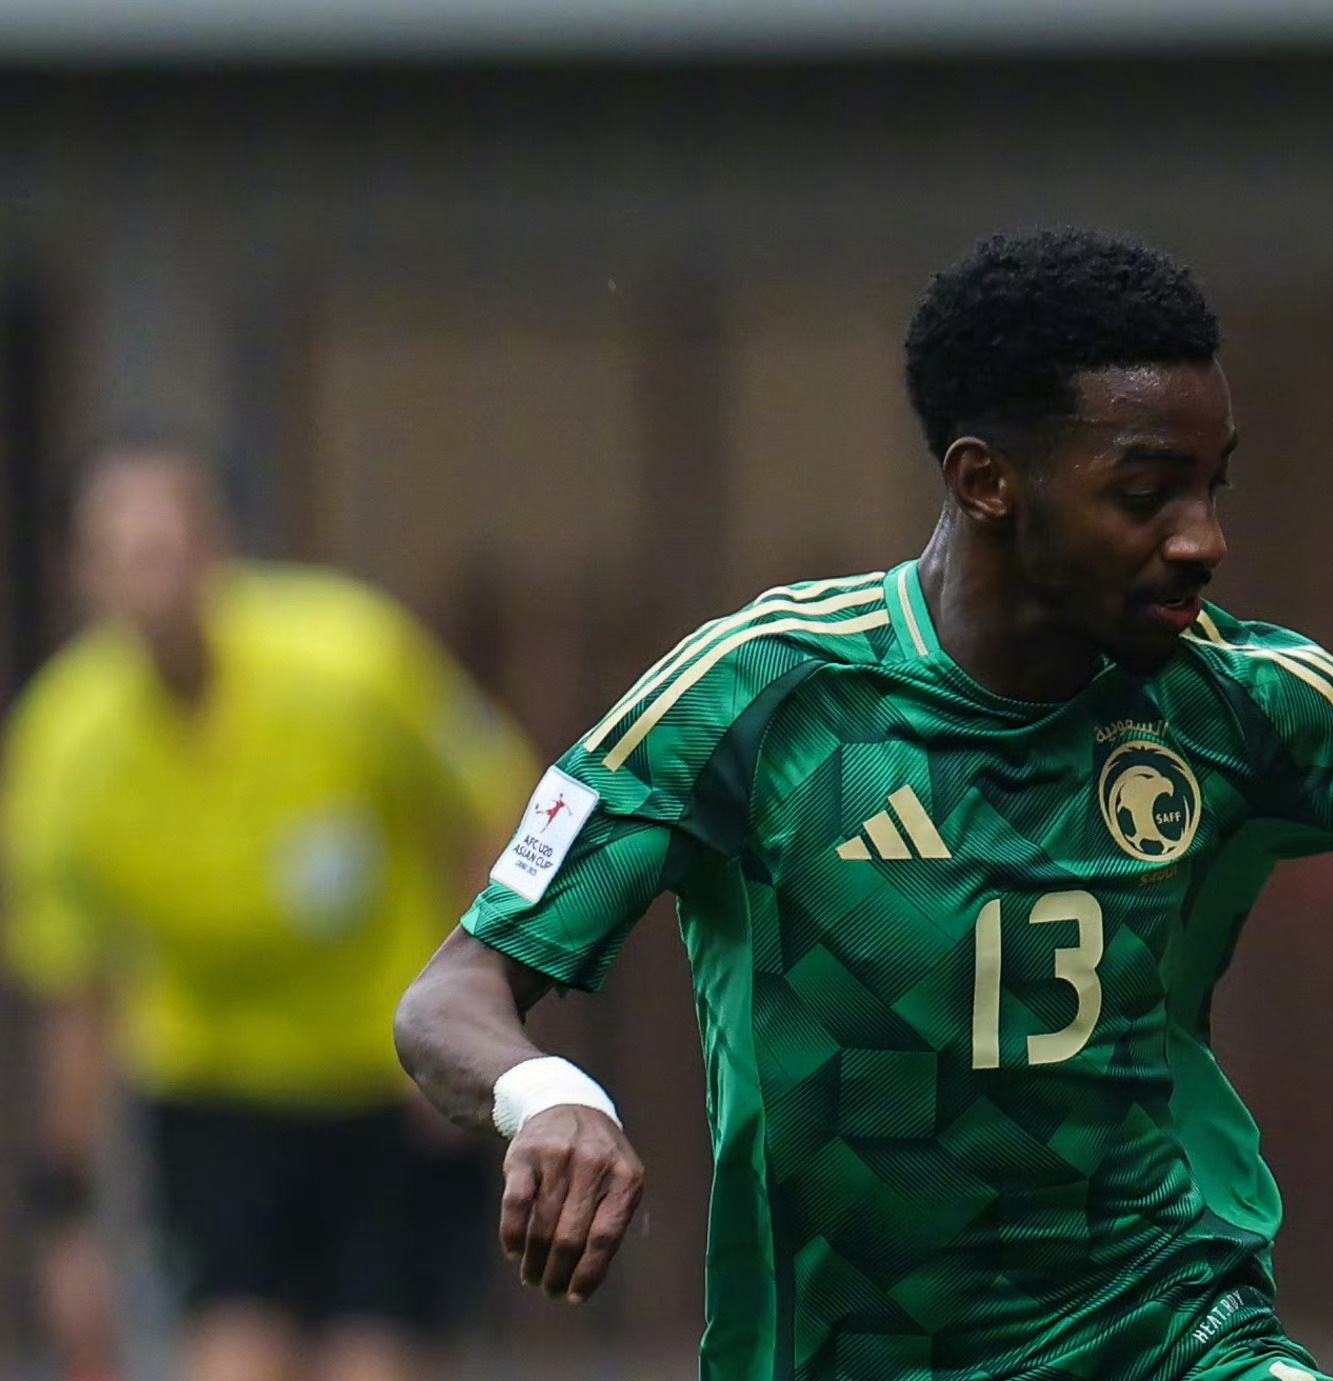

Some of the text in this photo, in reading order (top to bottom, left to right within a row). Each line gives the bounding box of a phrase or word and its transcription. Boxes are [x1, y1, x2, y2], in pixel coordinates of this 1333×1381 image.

[1155, 811, 1182, 825] SAFF
[513, 843, 537, 863] ASIAN
[535, 856, 555, 870] CUP
[523, 834, 554, 858] AFC U20
[971, 889, 1104, 1070] 13
[1191, 1289, 1245, 1344] HEAT.RDY
